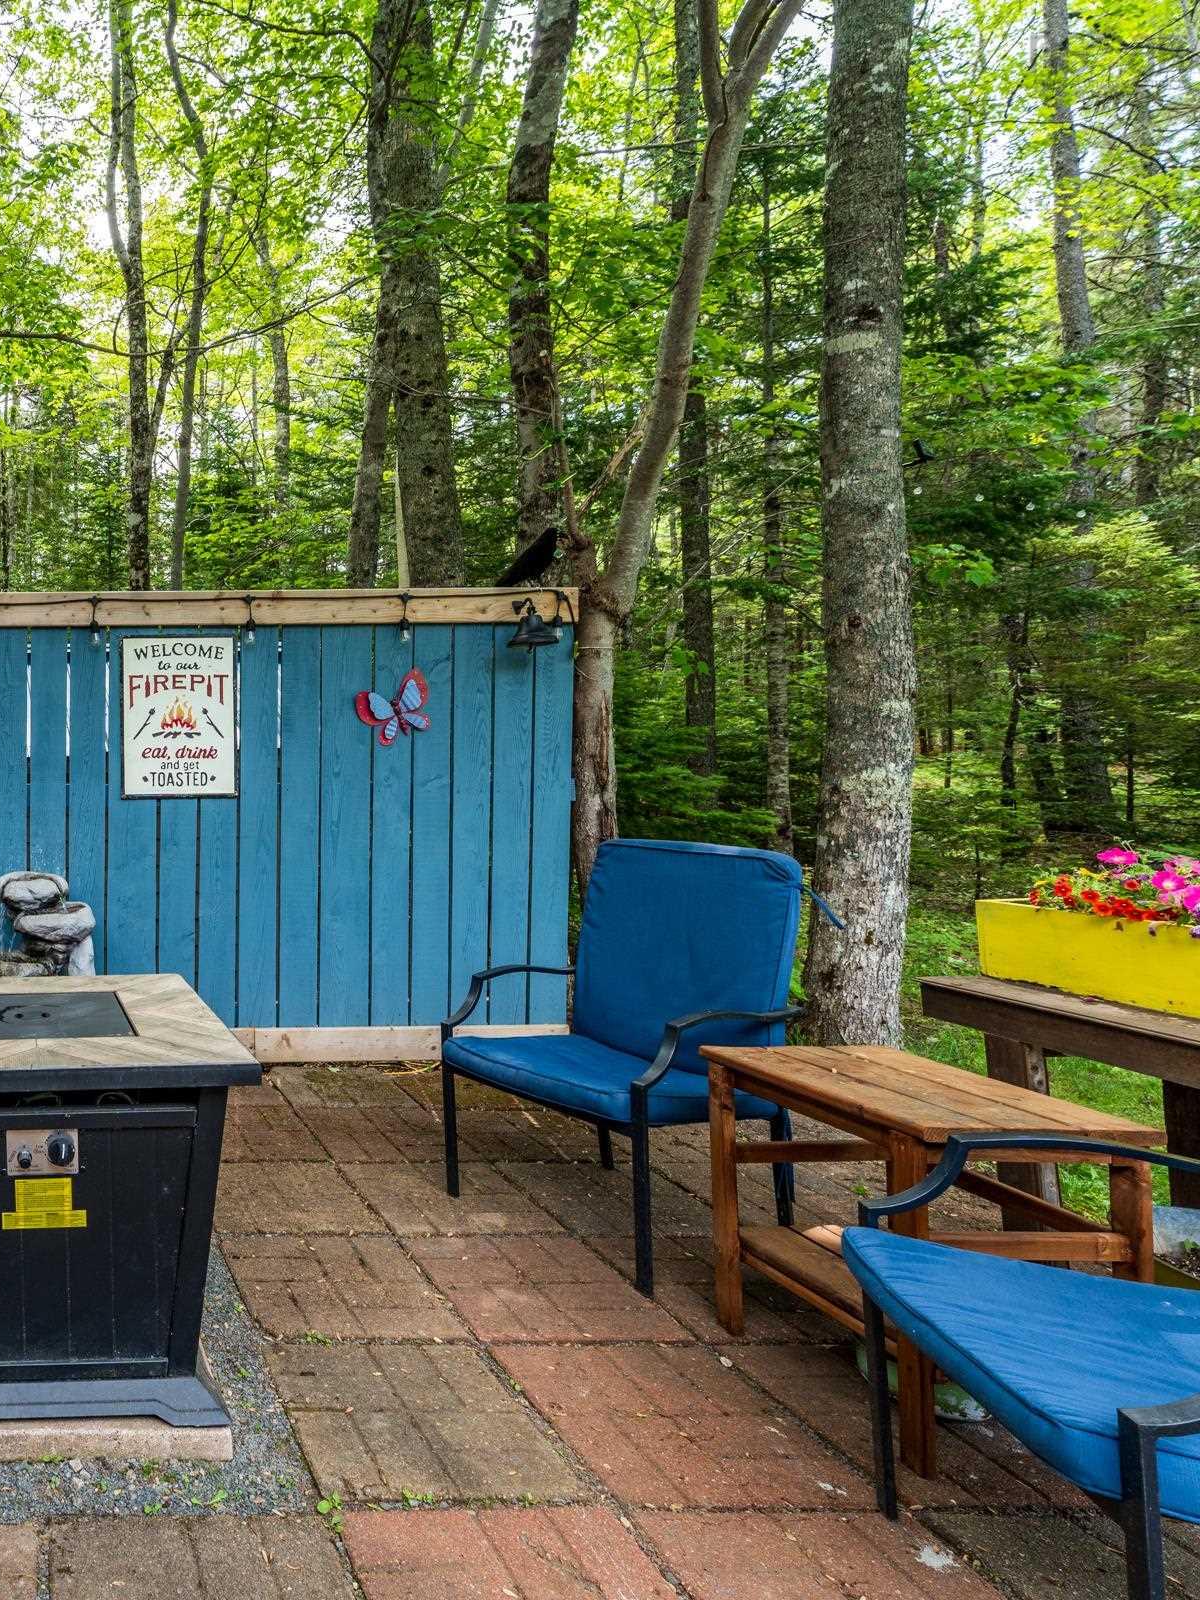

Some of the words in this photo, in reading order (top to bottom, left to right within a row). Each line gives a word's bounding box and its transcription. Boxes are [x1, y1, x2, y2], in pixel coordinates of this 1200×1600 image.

[134, 642, 224, 660] WELCOME
[158, 660, 172, 670] to
[176, 662, 200, 670] our
[128, 674, 229, 709] FIREPIT
[141, 746, 171, 760] eat,
[175, 745, 218, 760] drink
[160, 760, 180, 770] and
[183, 761, 200, 771] get
[150, 772, 208, 787] TOASTED
